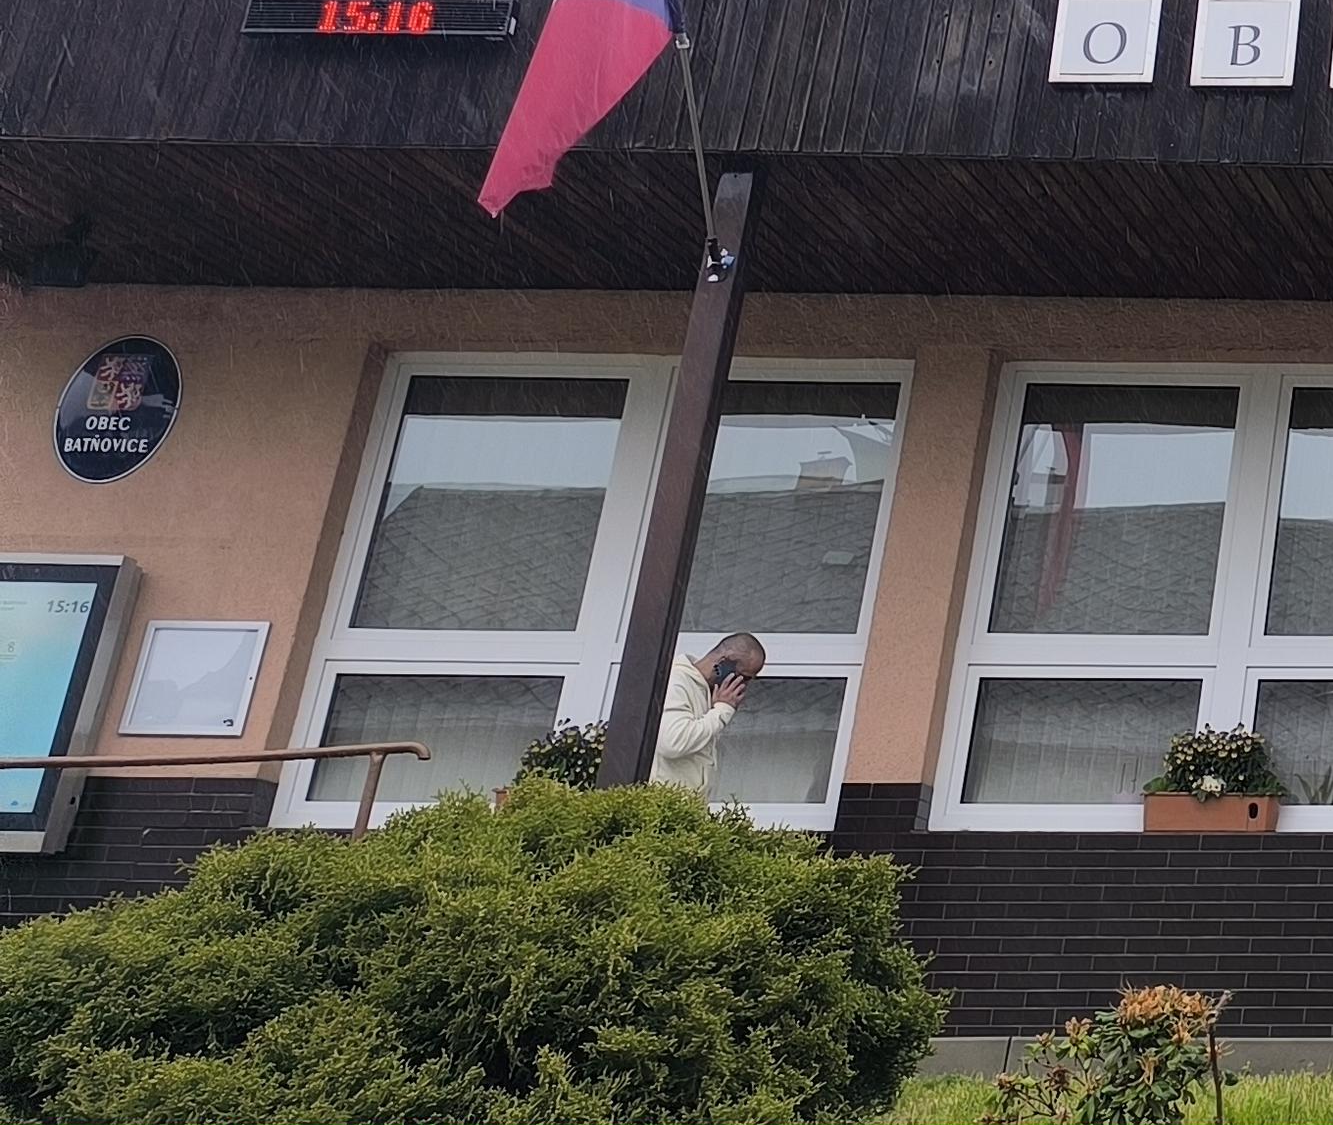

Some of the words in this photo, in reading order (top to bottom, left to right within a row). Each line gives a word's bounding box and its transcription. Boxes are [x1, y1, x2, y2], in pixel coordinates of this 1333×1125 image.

[318, 0, 434, 32] 15:16
[85, 416, 131, 431] OBEC
[64, 435, 149, 453] BATŇOVICE
[47, 600, 90, 613] 15:16
